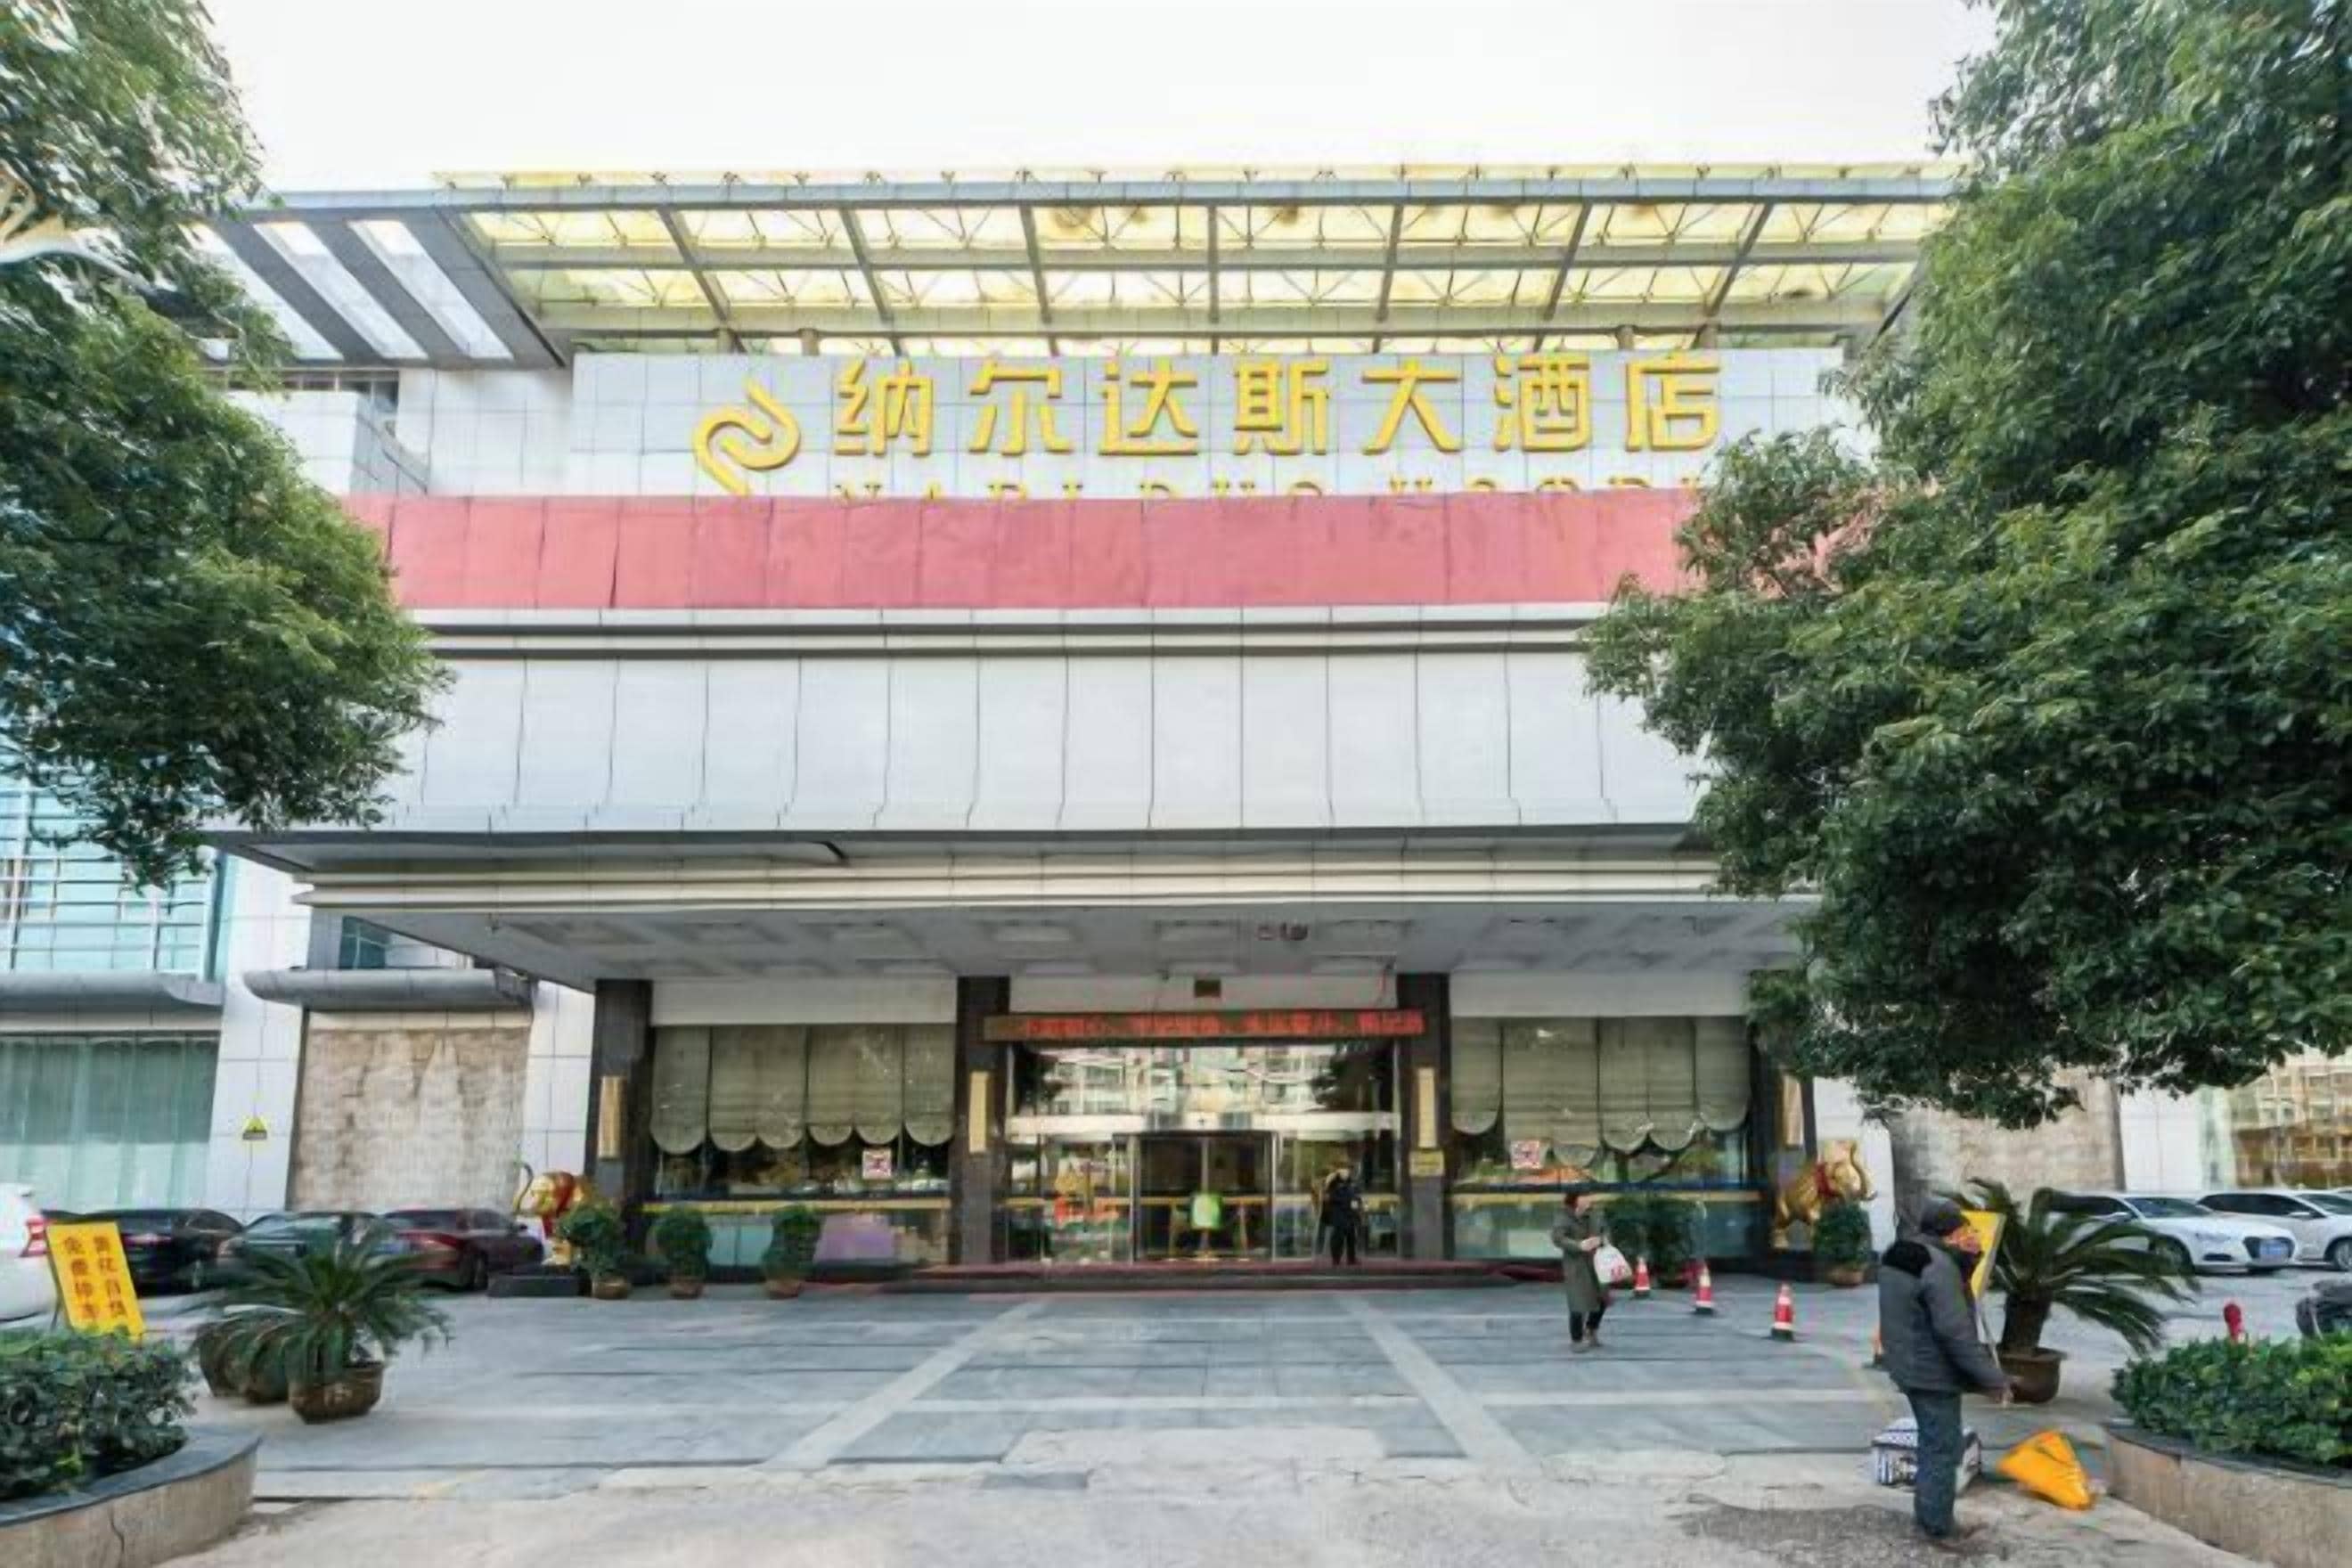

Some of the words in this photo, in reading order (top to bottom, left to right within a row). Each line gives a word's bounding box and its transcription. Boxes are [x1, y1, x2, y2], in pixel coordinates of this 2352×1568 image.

[833, 353, 1721, 456] 纳尔达斯大酒店
